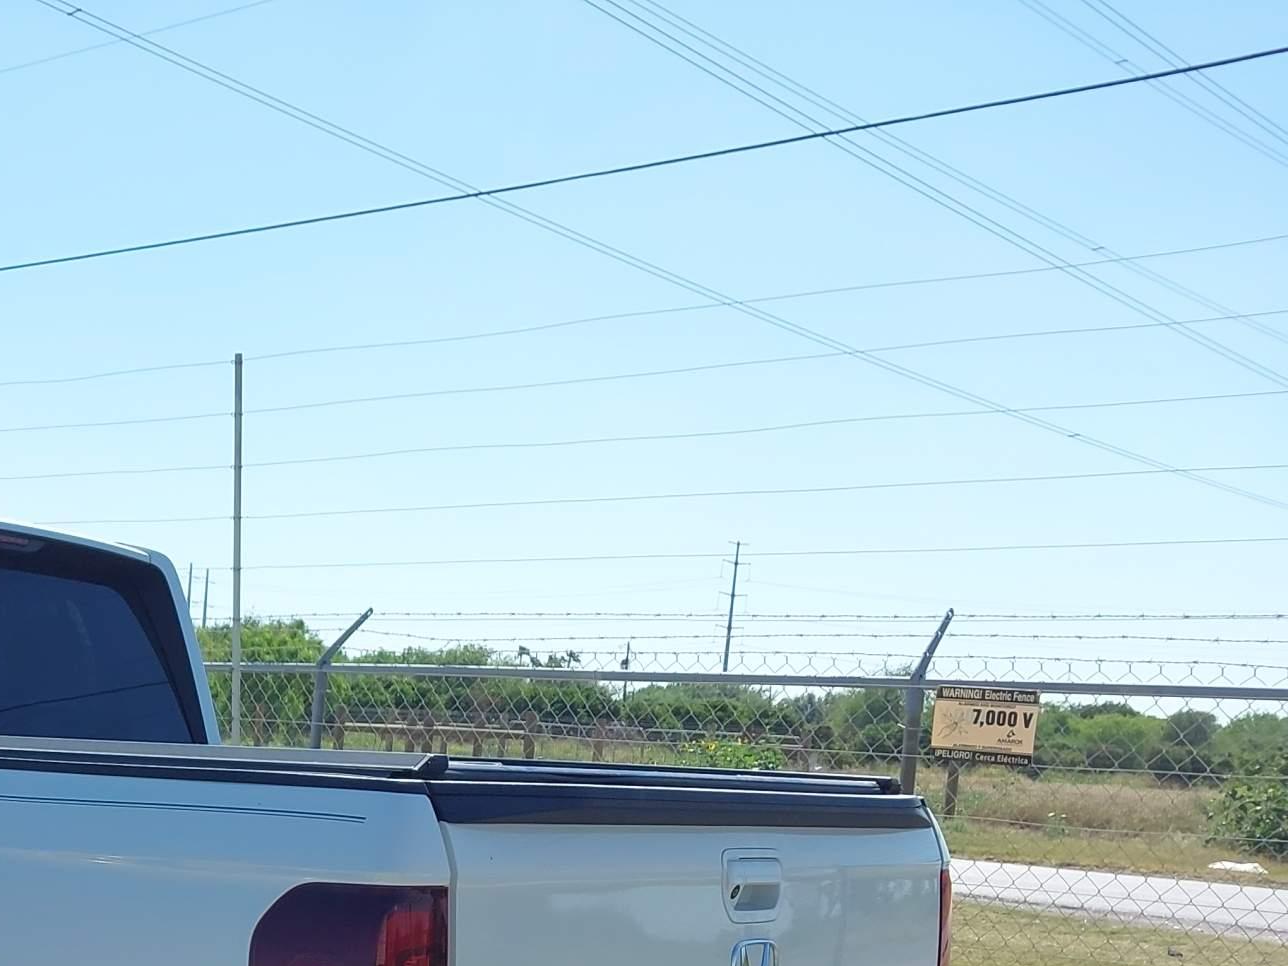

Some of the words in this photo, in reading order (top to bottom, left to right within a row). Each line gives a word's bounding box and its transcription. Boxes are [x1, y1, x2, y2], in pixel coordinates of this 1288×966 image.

[942, 687, 983, 699] WARNING!
[984, 690, 1012, 701] Electric
[1013, 692, 1035, 702] Fence
[972, 708, 1018, 728] 7,000
[1023, 712, 1034, 729] V
[974, 753, 995, 761] Cerca
[997, 755, 1029, 765] Eléctrica
